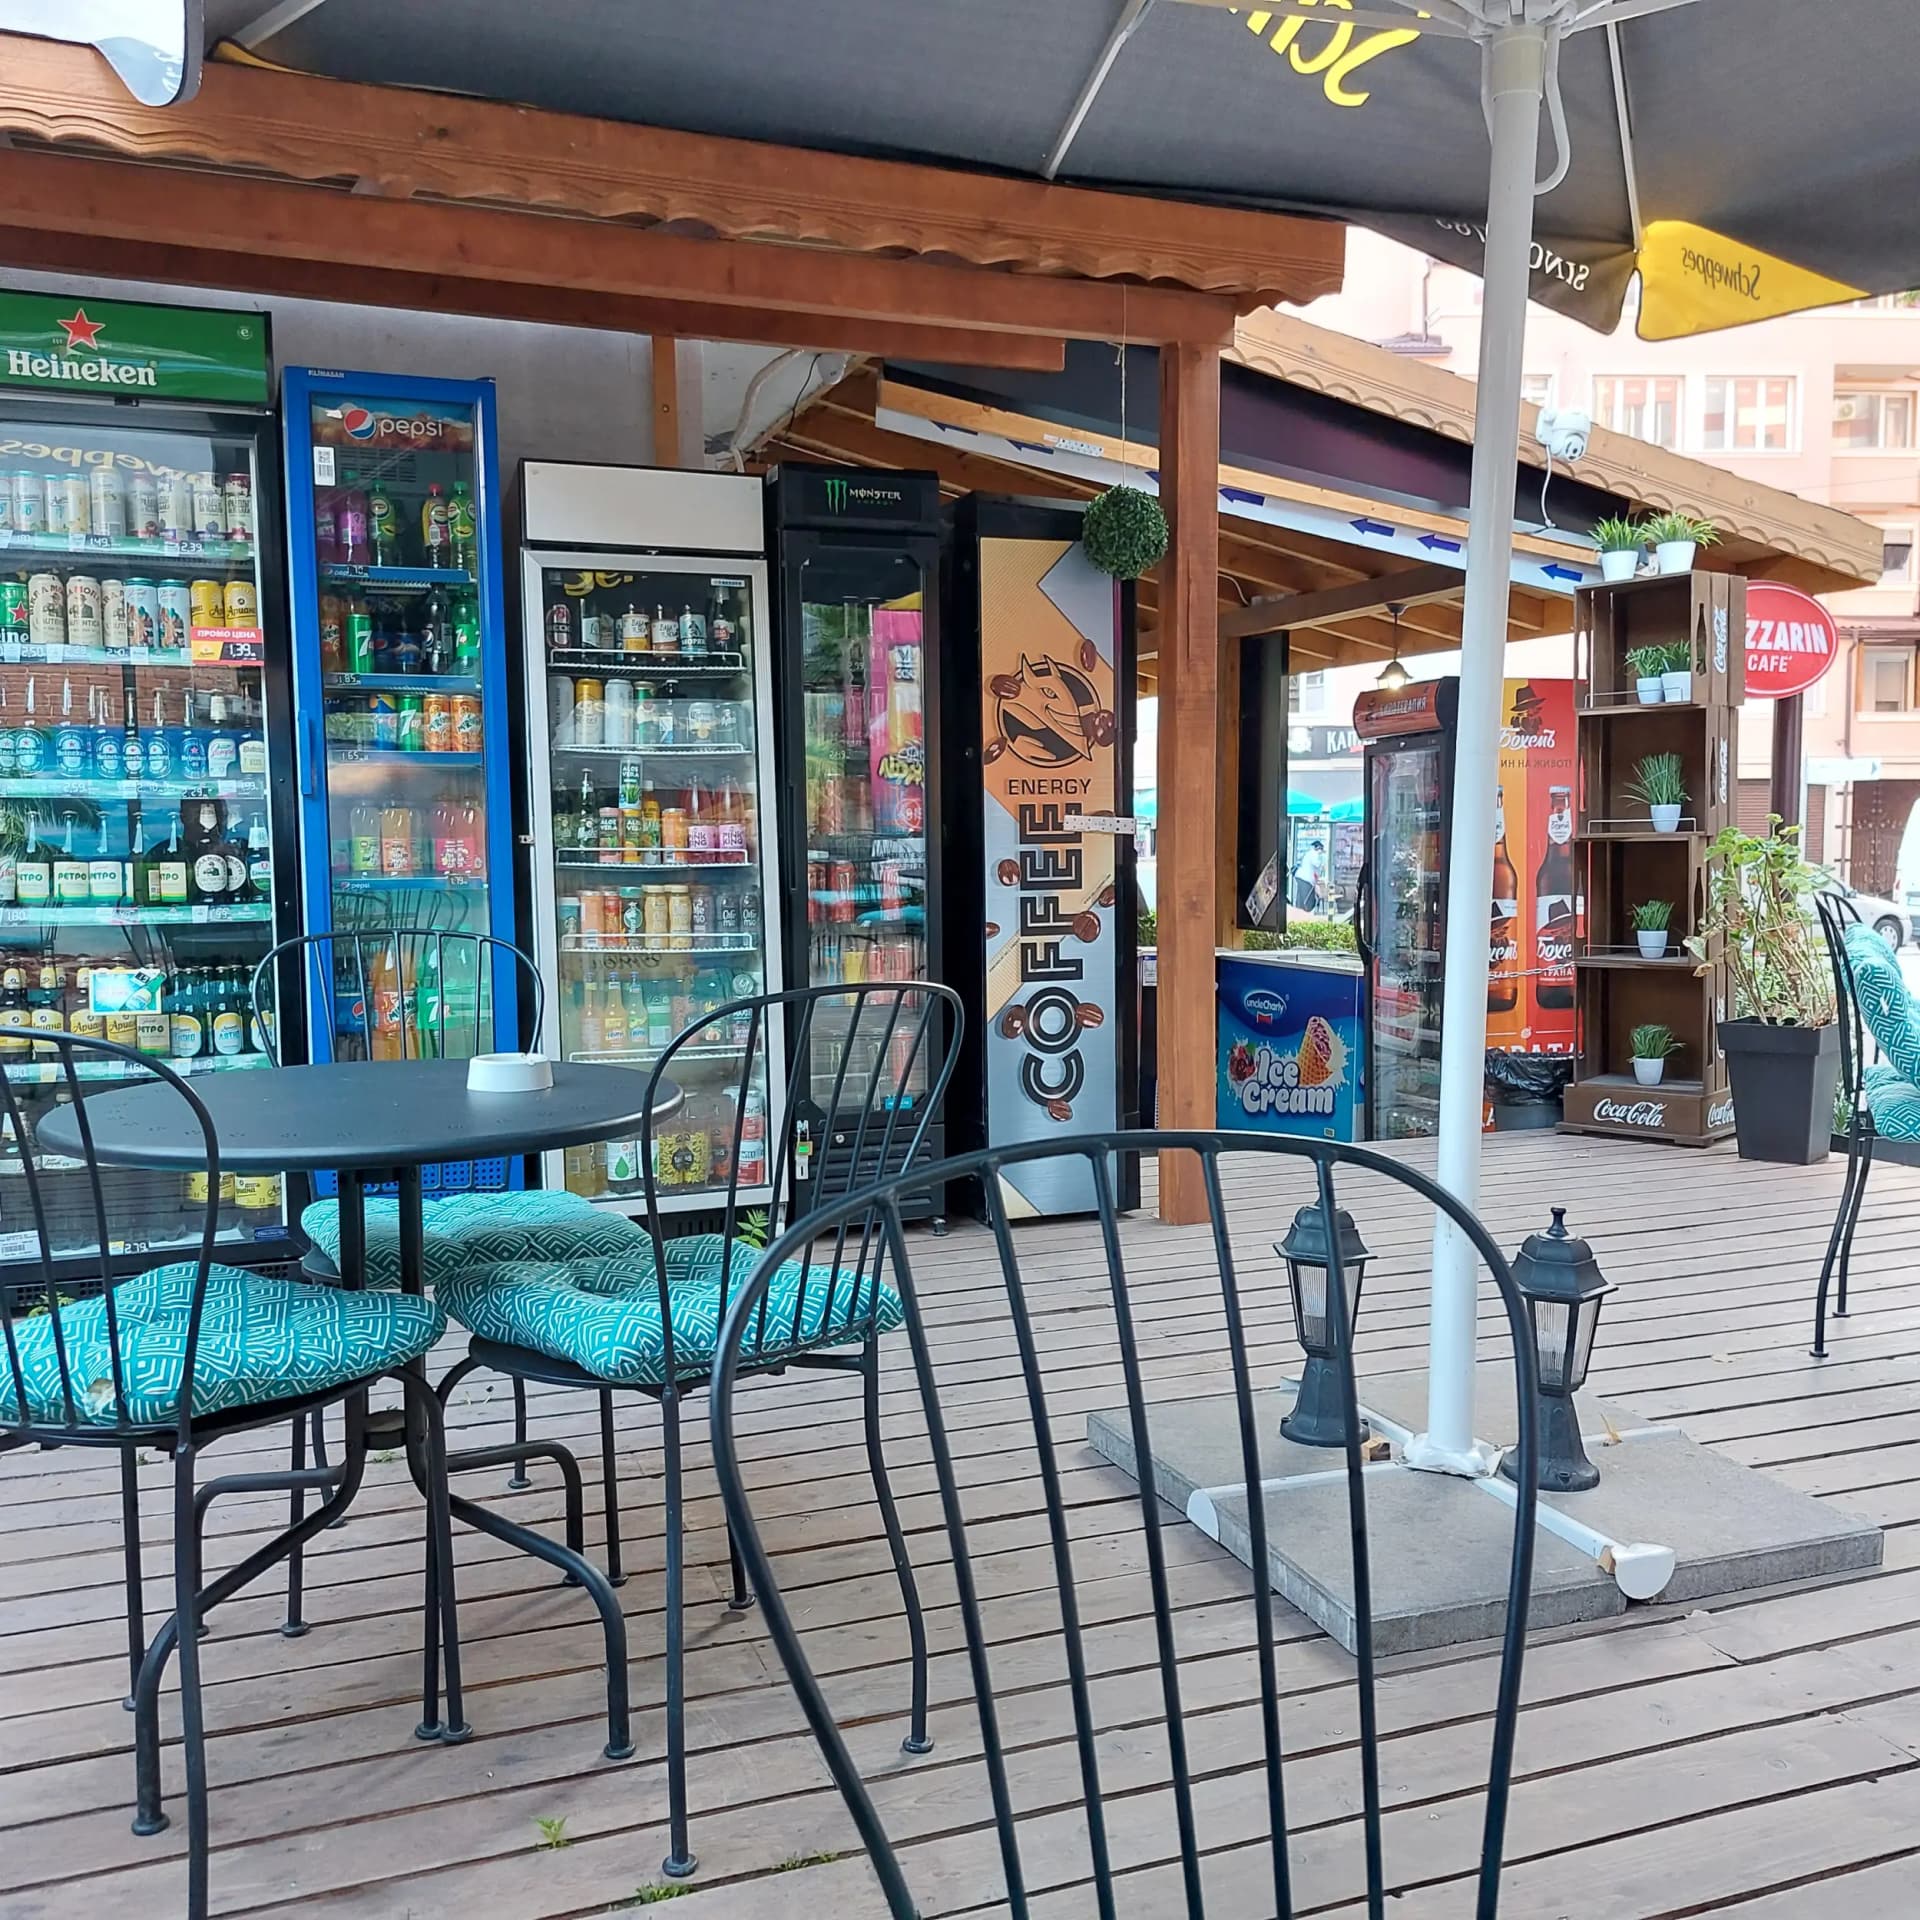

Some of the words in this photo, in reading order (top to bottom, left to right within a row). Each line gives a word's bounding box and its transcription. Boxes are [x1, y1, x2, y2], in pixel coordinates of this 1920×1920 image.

[8, 349, 157, 386] Heineken
[380, 419, 443, 438] pepsi
[197, 630, 230, 638] ПРОМО
[231, 630, 257, 639] ЦЕНА
[1008, 778, 1092, 796] ENERGY
[722, 831, 744, 840] PINK
[722, 839, 743, 847] KING
[1018, 802, 1085, 1106] COFFEE
[1257, 1048, 1299, 1088] Ice
[1242, 1080, 1335, 1114] Cream
[1593, 1097, 1668, 1128] Coca-Cola
